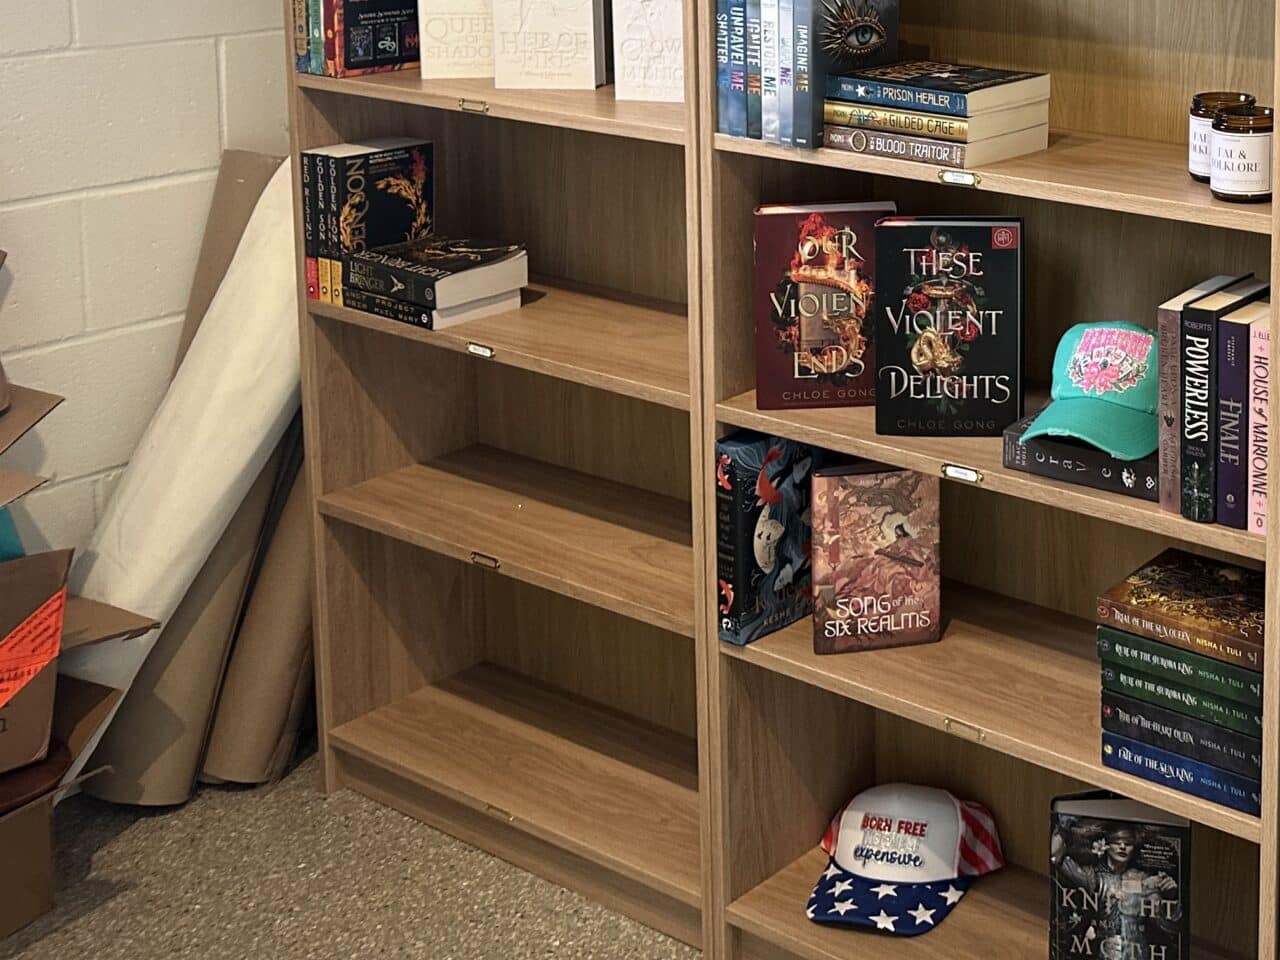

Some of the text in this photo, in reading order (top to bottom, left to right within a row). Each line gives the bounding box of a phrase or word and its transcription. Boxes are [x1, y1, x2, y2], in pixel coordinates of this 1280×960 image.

[716, 13, 728, 64] SHATTER
[729, 6, 744, 92] UNRAVEL ME
[796, 24, 809, 92] IMAGINE ME
[882, 88, 950, 109] PRISON HEALER
[889, 113, 955, 135] GILDED CAGE
[875, 138, 950, 161] BLOOD TRAITOR
[1239, 151, 1246, 159] &
[316, 157, 324, 209] GOLDEN
[798, 227, 865, 262] OUR
[902, 248, 984, 278] THESE
[885, 299, 1003, 336] VIOLENT
[793, 345, 865, 378] ENDS
[878, 365, 1010, 404] DELIGHTS
[1185, 334, 1209, 442] POWERLESS
[1253, 355, 1269, 405] HOUSE
[896, 419, 996, 430] CHLOE GONG
[1219, 398, 1242, 466] FINALE
[1251, 423, 1268, 496] MARIONNE
[824, 610, 930, 638] SIX REALMS
[836, 595, 891, 619] SONG
[1196, 638, 1242, 656] NISHA TULI
[862, 813, 928, 837] BORN FREE
